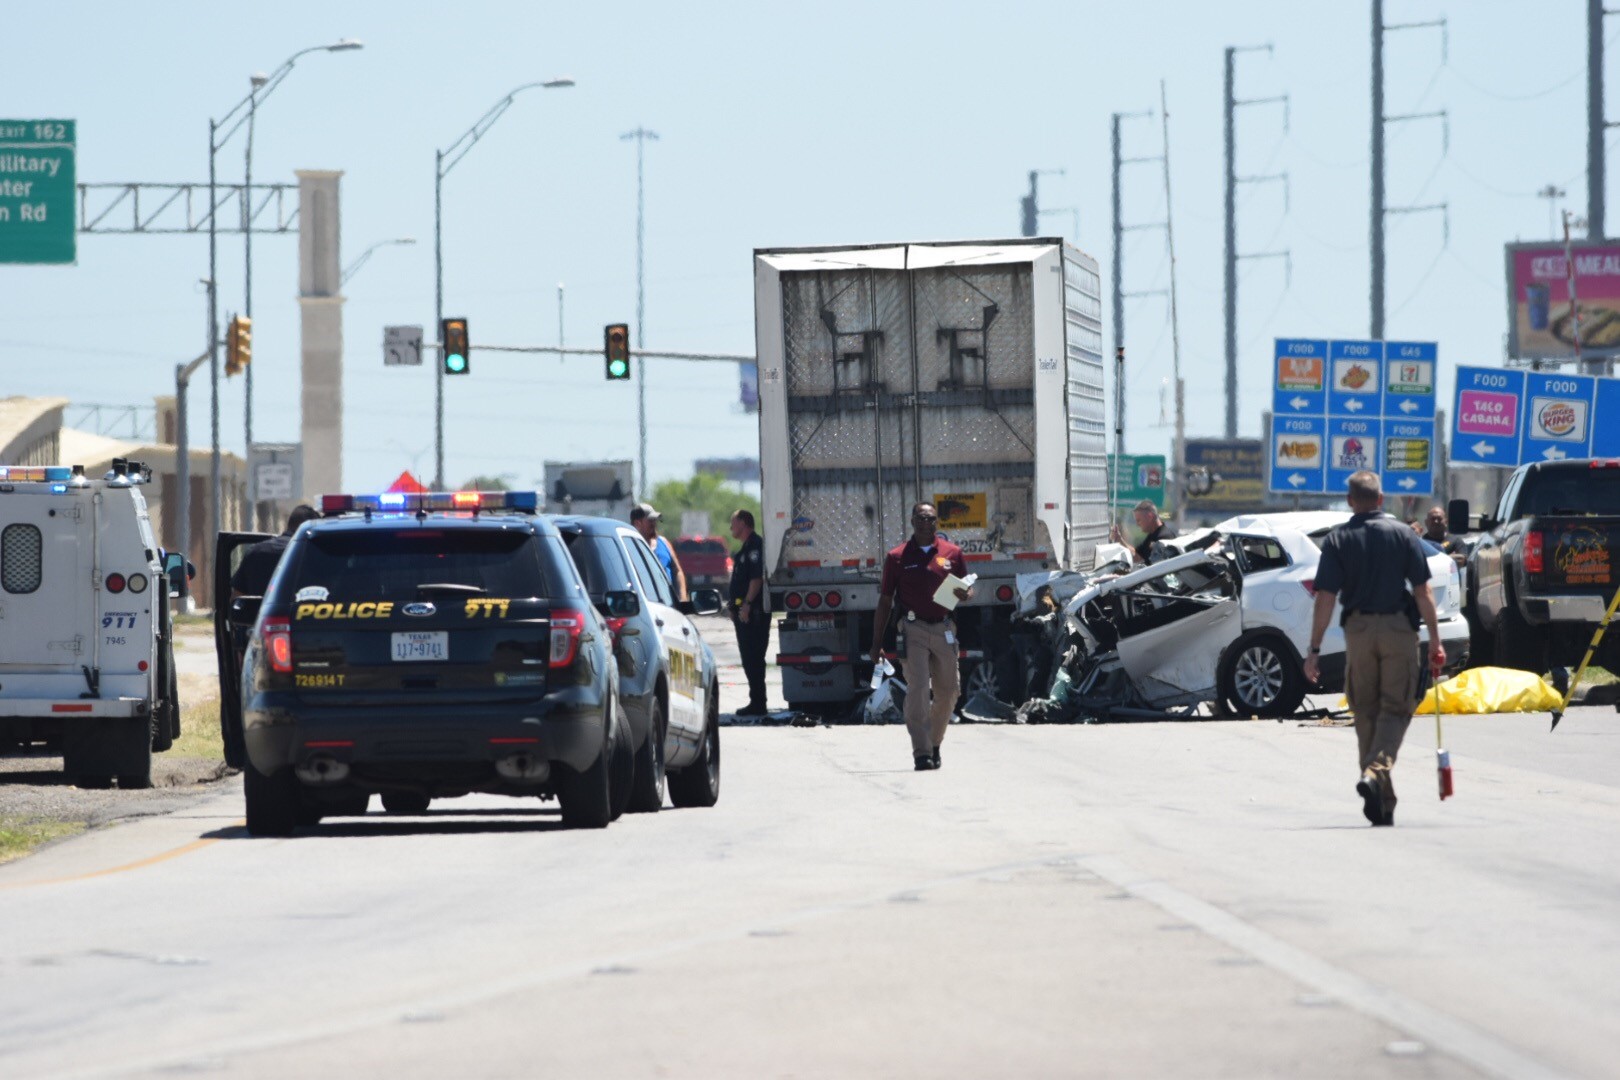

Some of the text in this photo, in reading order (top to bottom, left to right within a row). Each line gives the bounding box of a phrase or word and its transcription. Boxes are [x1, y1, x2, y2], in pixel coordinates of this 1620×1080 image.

[34, 124, 66, 139] 162
[20, 203, 47, 222] Rd
[1288, 343, 1314, 354] FOOD
[1343, 345, 1369, 355] FOOD
[1473, 373, 1507, 387] FOOD
[1545, 380, 1577, 393] FOOD
[1473, 400, 1503, 413] TACO
[1543, 407, 1575, 418] BURGER
[1286, 420, 1312, 430] FOOD
[1462, 413, 1510, 426] CABANA
[1544, 416, 1575, 427] KING
[1341, 422, 1367, 432] FOOD
[1393, 425, 1420, 435] FOOD
[955, 540, 993, 553] 2573
[296, 602, 394, 620] POLICE
[464, 603, 510, 618] 911
[102, 617, 135, 628] 911
[106, 636, 126, 645] 7945
